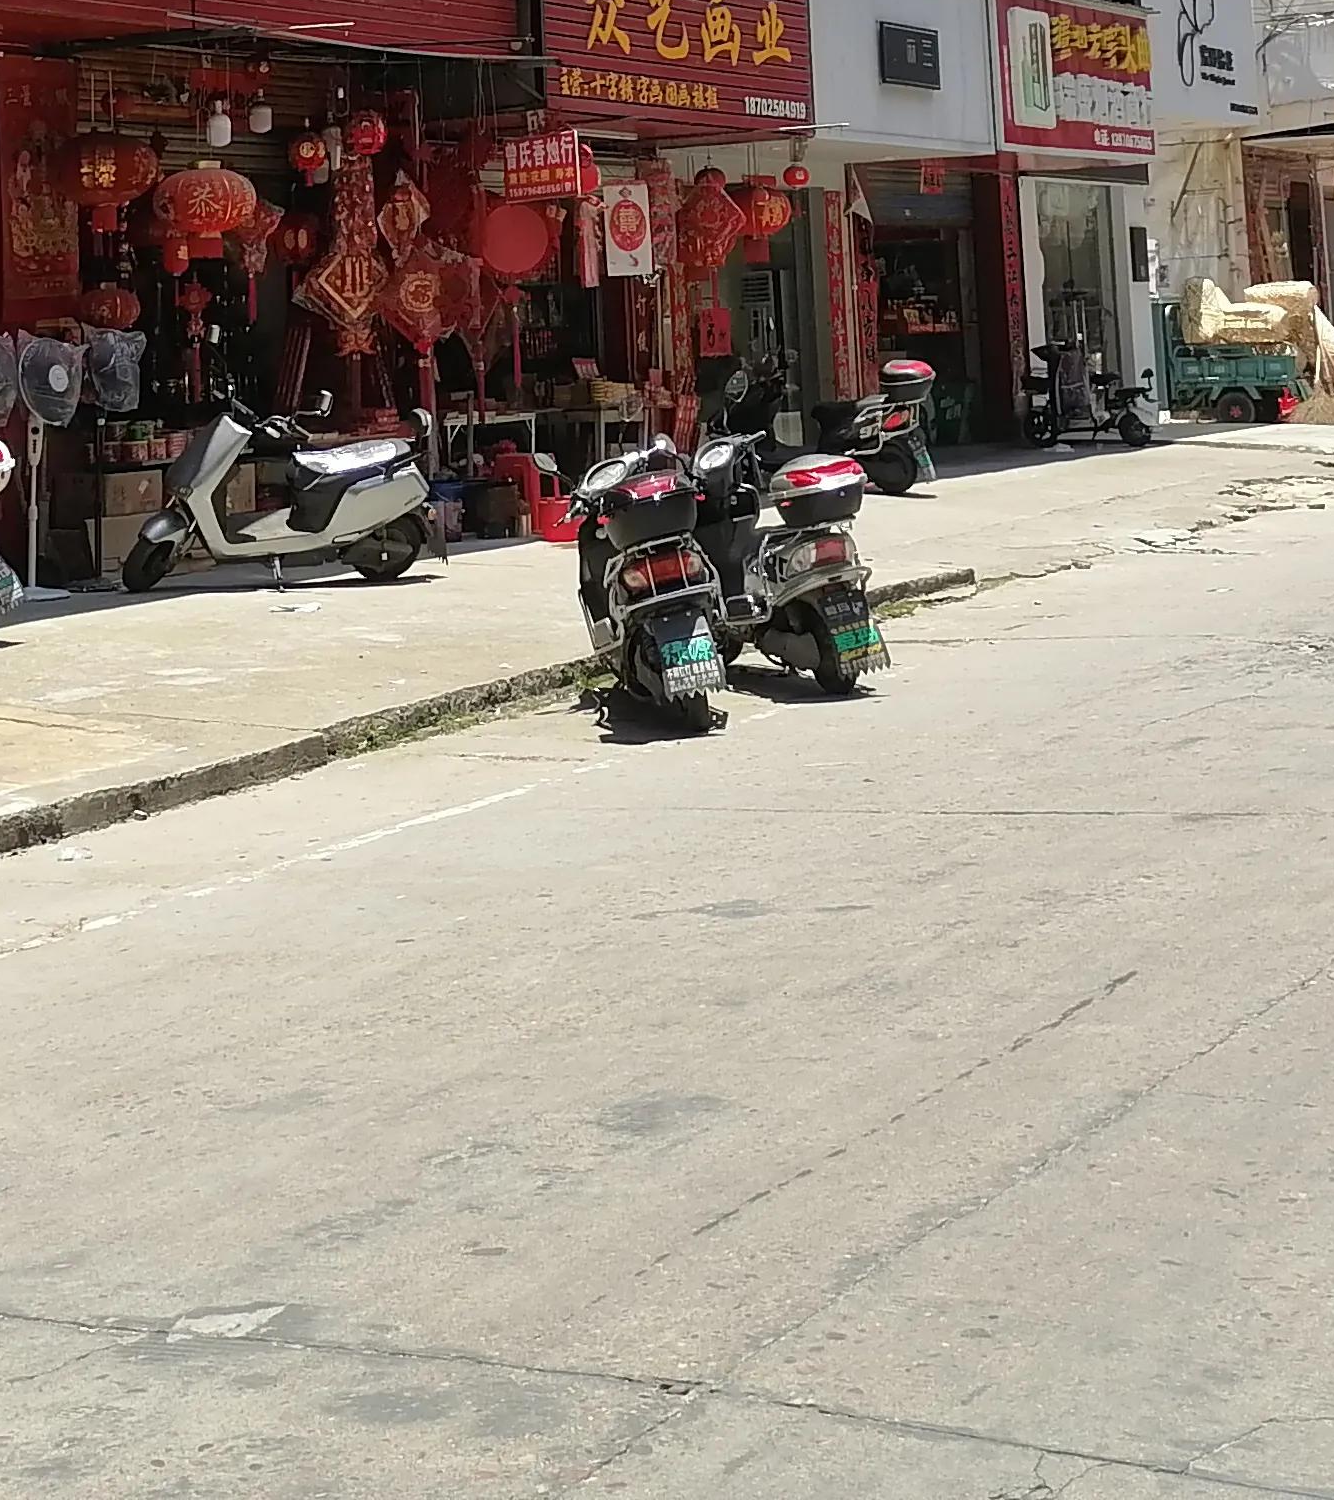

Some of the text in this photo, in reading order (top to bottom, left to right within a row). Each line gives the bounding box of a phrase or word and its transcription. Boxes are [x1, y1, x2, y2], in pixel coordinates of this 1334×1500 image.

[505, 135, 574, 171] 曾氏香烛行
